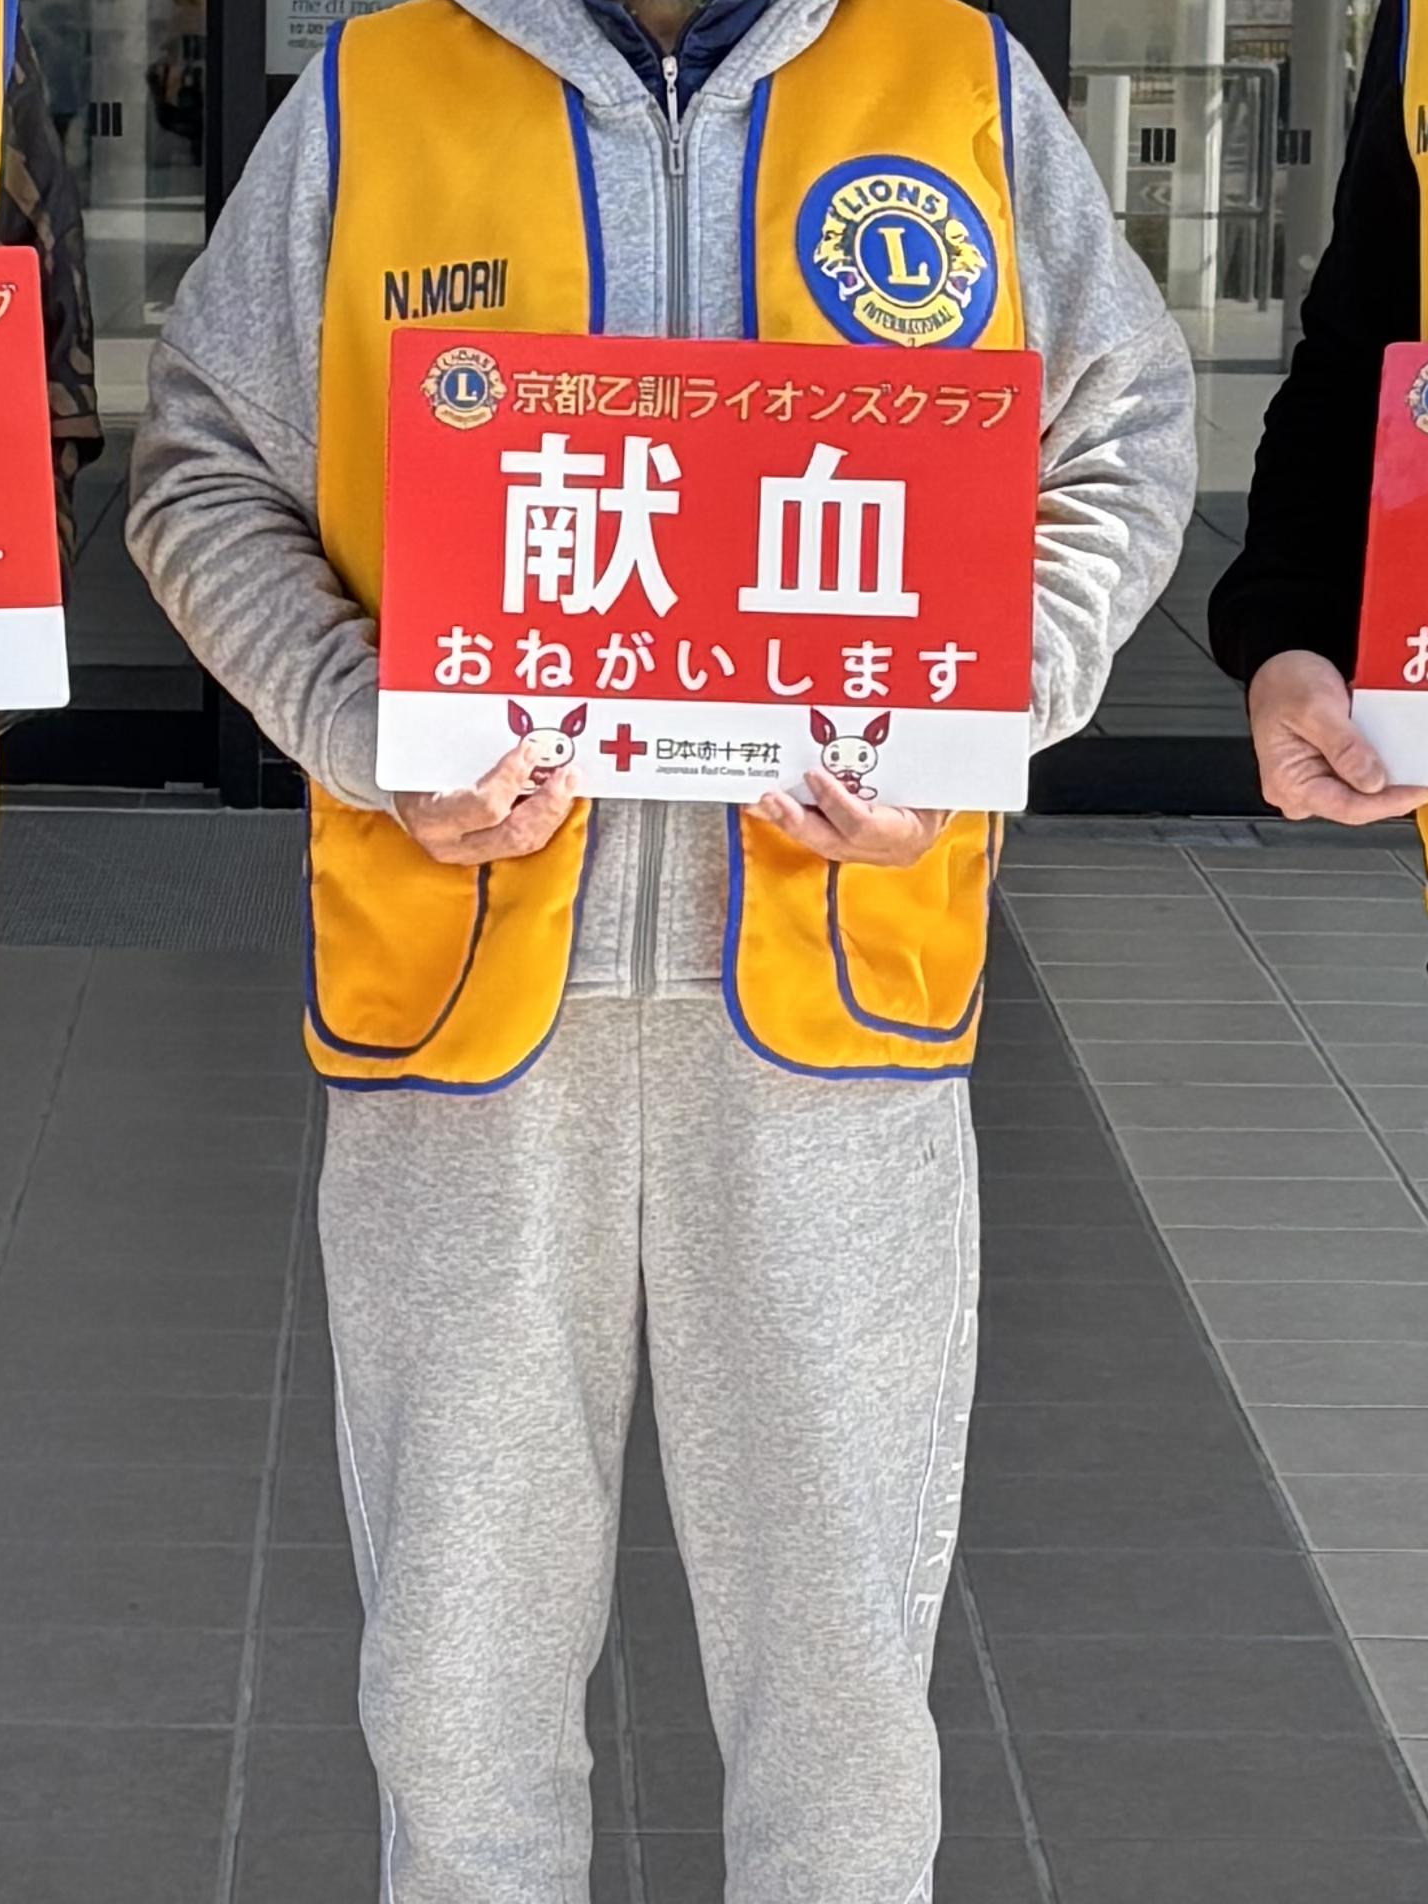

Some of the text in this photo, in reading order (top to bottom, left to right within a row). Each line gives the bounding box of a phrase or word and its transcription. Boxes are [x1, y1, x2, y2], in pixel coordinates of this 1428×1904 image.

[839, 179, 941, 216] LIONS
[876, 227, 931, 286] L
[383, 258, 508, 322] N.MORII
[512, 370, 1020, 430] 京都乙訓ライオンズクラブ
[500, 433, 919, 617] 献血
[434, 627, 978, 704] おねがいします
[656, 738, 781, 764] 日本赤十字社
